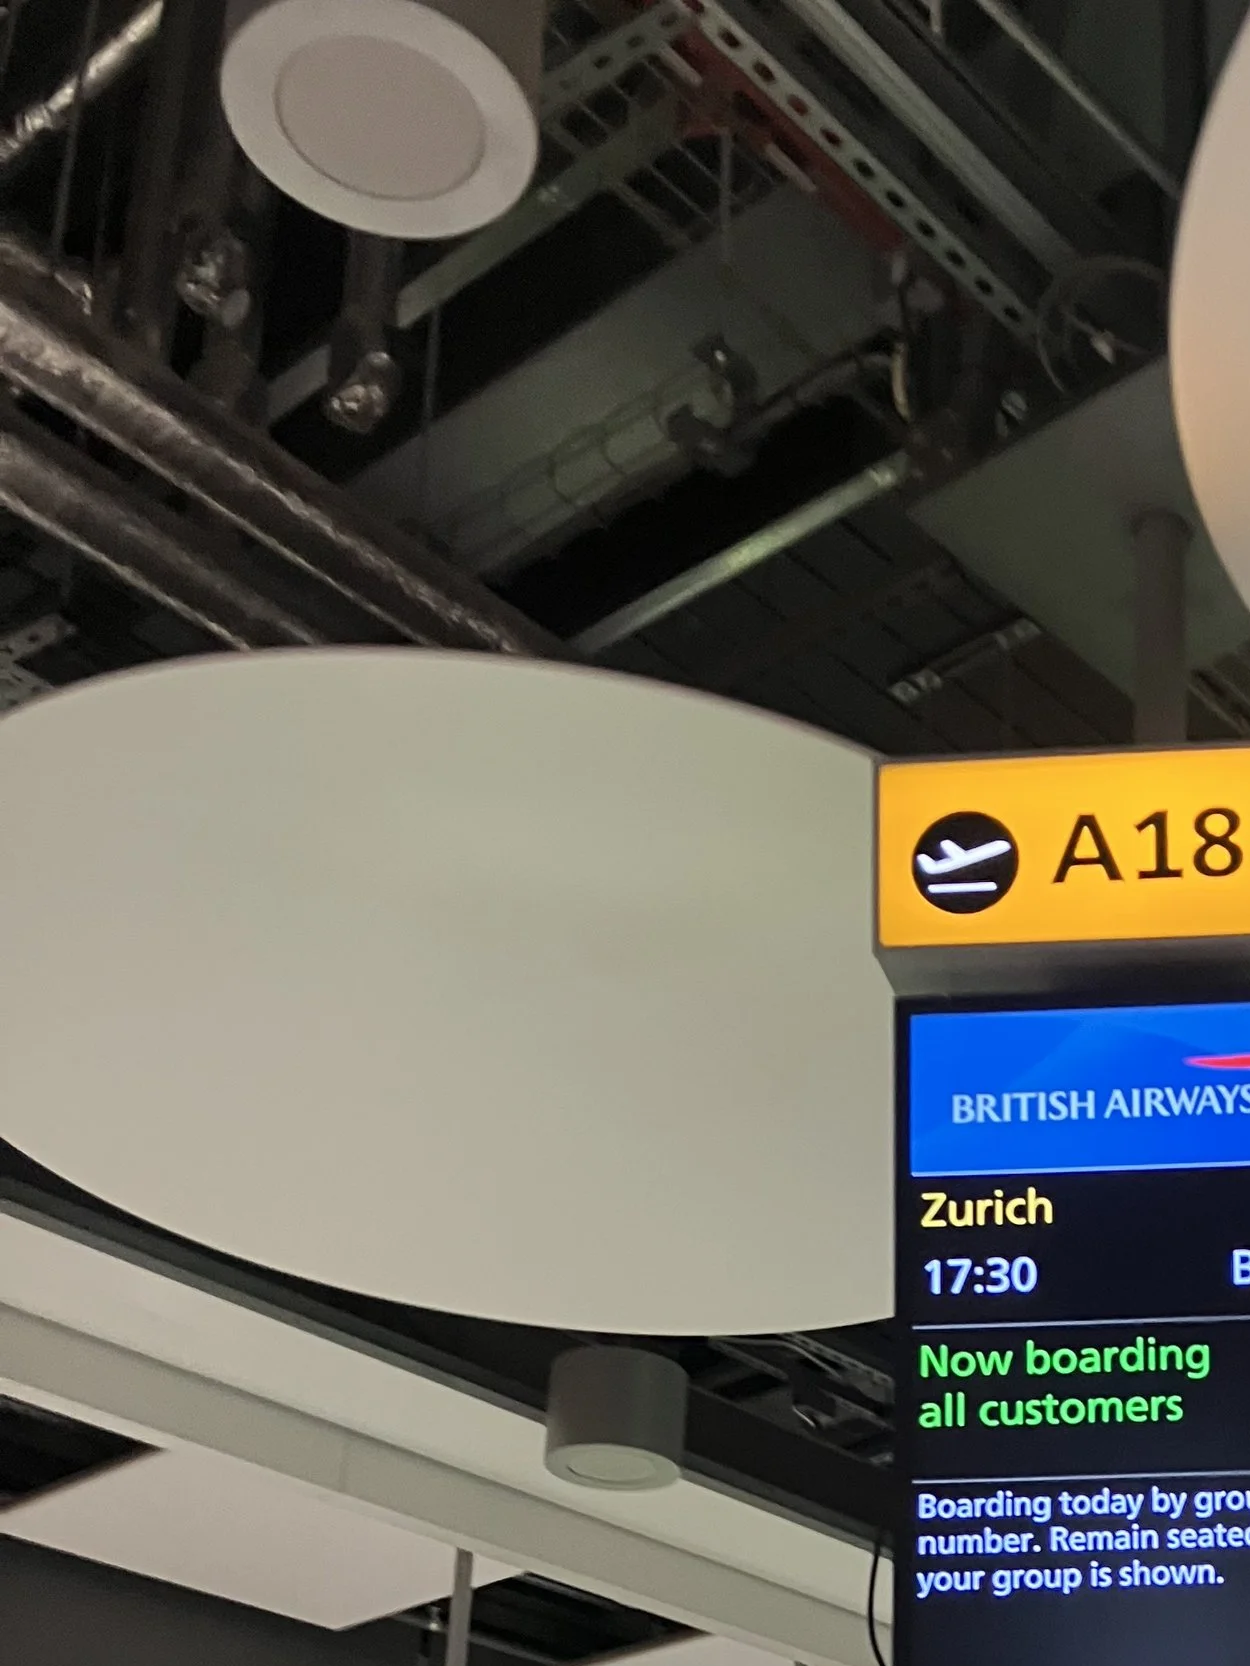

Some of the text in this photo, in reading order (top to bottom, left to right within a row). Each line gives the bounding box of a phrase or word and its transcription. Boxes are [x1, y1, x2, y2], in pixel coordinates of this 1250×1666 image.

[1053, 808, 1243, 884] A18
[952, 1090, 1096, 1124] BRITISH
[920, 1186, 1053, 1228] Zurich
[923, 1256, 1038, 1295] 17:30
[919, 1336, 1210, 1380] Now boarding
[918, 1391, 1184, 1428] all customers
[917, 1490, 1052, 1523] Boarding
[1058, 1487, 1145, 1520] today
[1151, 1485, 1187, 1518] by
[917, 1526, 1042, 1556] number.
[1050, 1522, 1160, 1552] Remain
[916, 1558, 1225, 1599] your group is shown.
